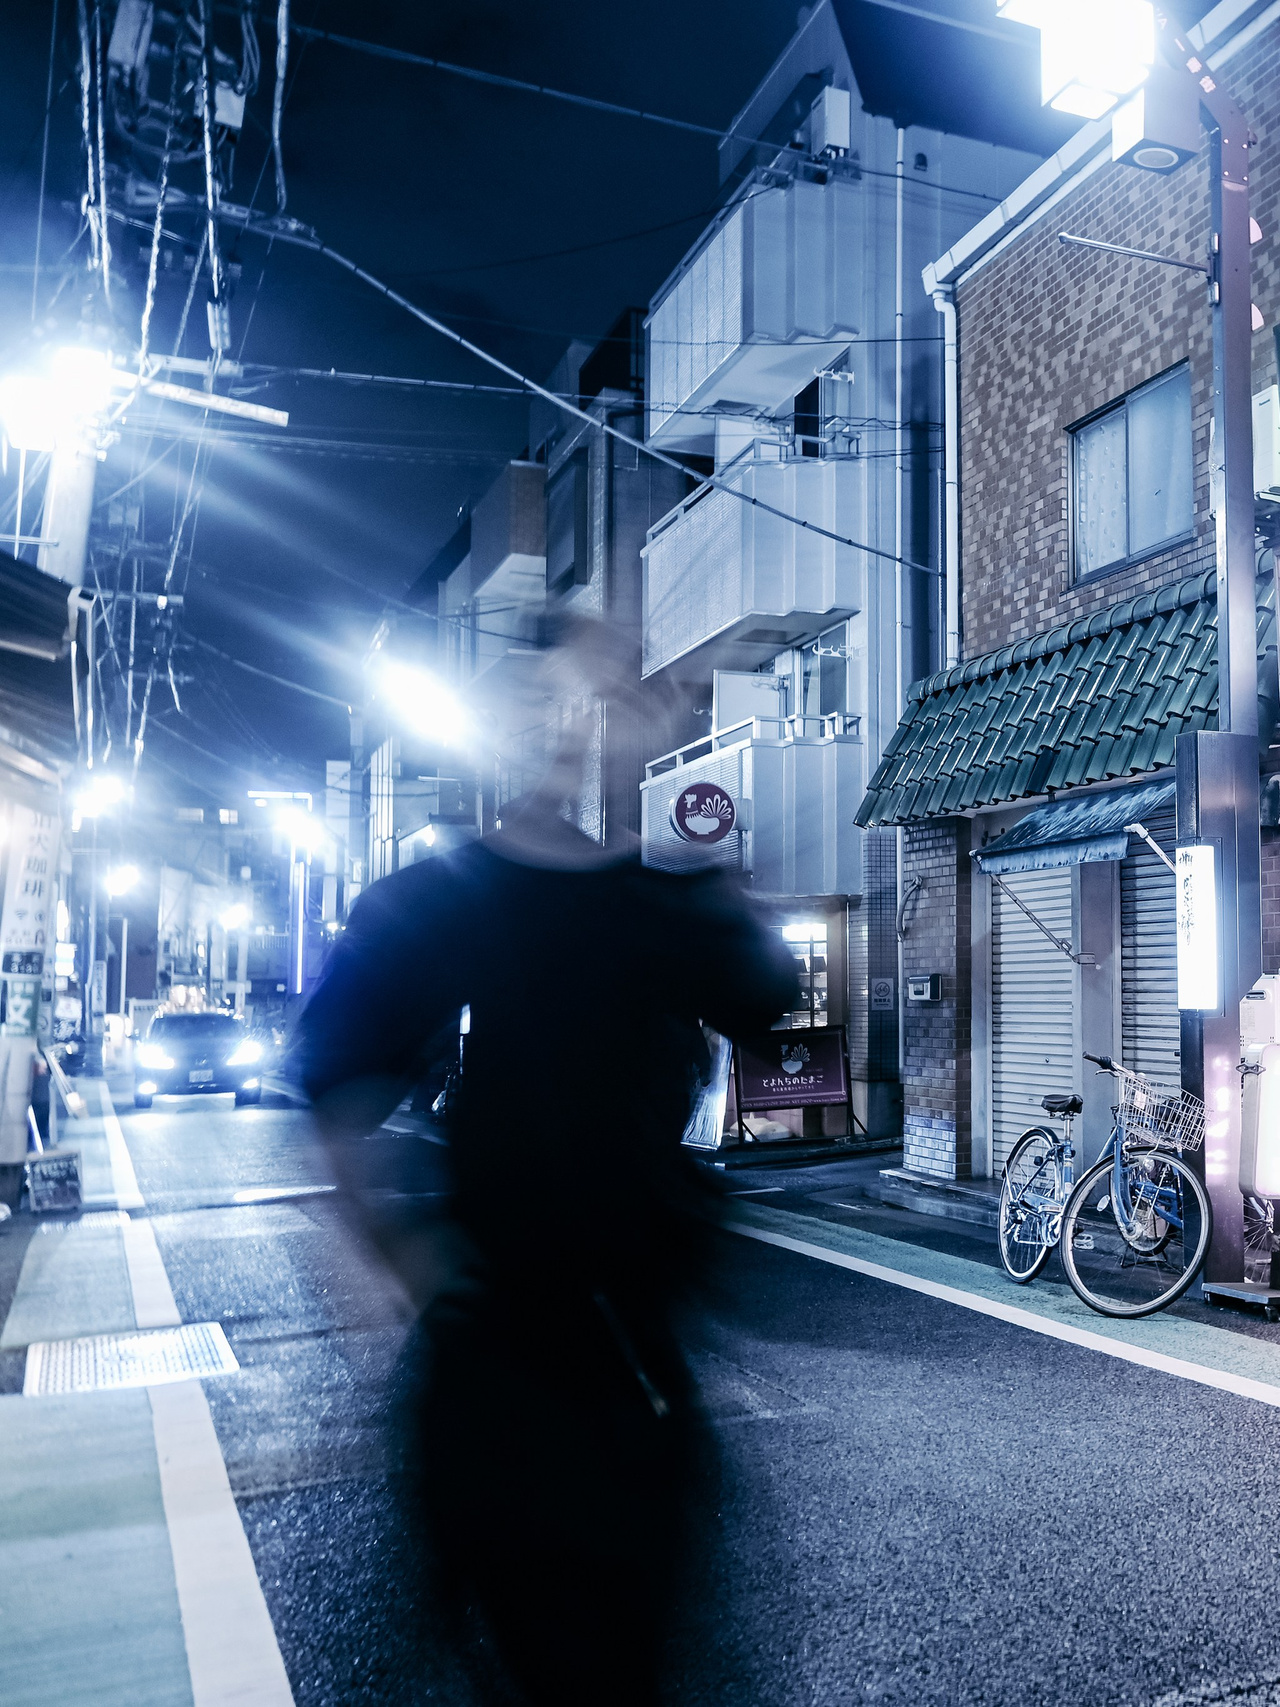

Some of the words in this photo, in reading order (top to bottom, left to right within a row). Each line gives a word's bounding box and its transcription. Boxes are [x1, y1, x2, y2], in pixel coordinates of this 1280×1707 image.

[762, 1074, 824, 1088] とよんちのたまご
